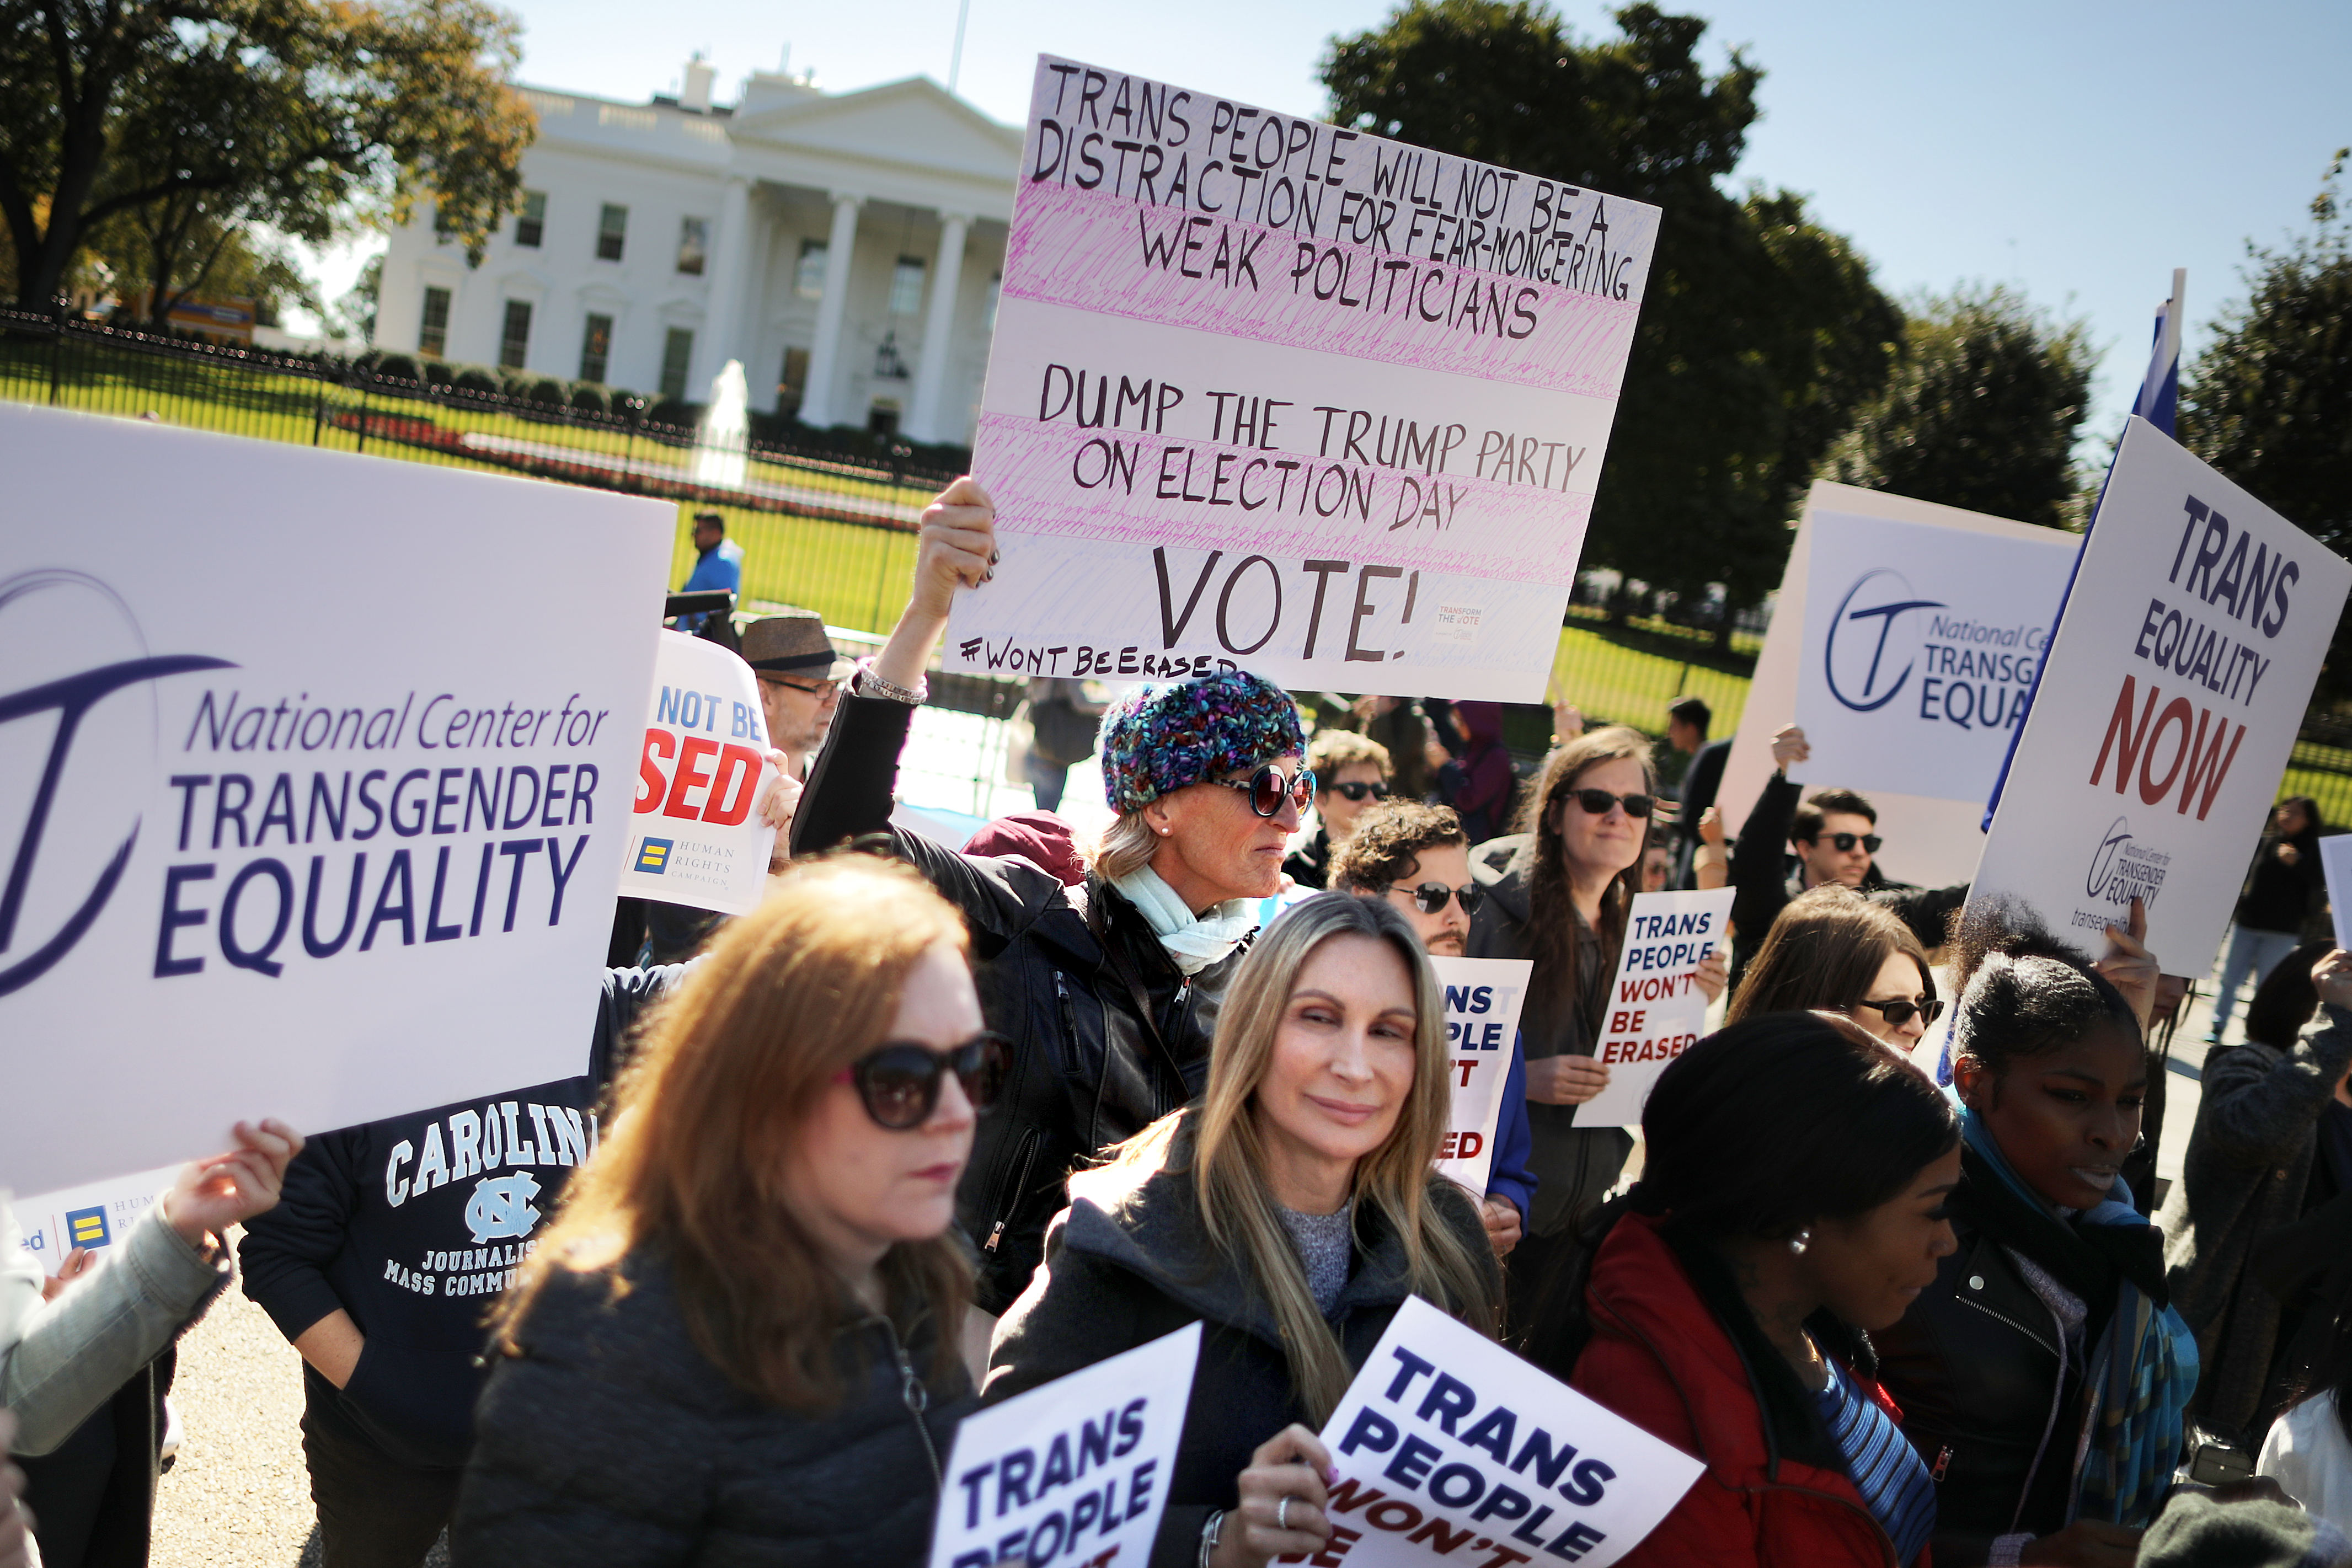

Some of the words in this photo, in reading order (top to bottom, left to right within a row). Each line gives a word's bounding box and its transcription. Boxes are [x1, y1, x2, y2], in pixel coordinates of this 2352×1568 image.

[1050, 64, 1191, 147] TRANS
[1208, 100, 1358, 186] PEOPLE
[1373, 145, 1442, 210] WILL
[1455, 163, 1519, 224] NOT
[1530, 180, 1580, 241] BE
[1585, 195, 1609, 245] A
[1031, 119, 1324, 239] DISTRACTION
[1335, 190, 1396, 255] FOR
[1406, 208, 1632, 301] FEAR-MONGERING
[1140, 209, 1266, 292] WEAK
[1291, 242, 1539, 339] POLITICIANS
[1039, 363, 1184, 435] DUMP
[1206, 391, 1294, 451] THE
[1313, 406, 1467, 477] TRUMP
[1476, 430, 1586, 493] PARTY
[1073, 438, 1140, 496] ON
[1156, 446, 1375, 524] ELECTION
[1388, 476, 1469, 531] DAY
[2169, 494, 2300, 639] TRANS
[1153, 545, 1420, 662] VOTE!
[1439, 613, 1455, 623] THE
[1440, 606, 1482, 616] TRANSFORM
[1929, 614, 2023, 649] National
[2135, 597, 2270, 707] EQUALITY
[184, 690, 415, 752] National
[418, 693, 554, 749] Center
[553, 693, 610, 750] for
[657, 685, 722, 732] NOT
[731, 700, 762, 742] BE
[2089, 674, 2247, 822] NOW
[169, 763, 599, 851] TRANSGENDER
[671, 870, 728, 886] CAMPAIGN
[675, 855, 731, 873] RIGHTS
[679, 841, 735, 858] HUMAN
[2116, 858, 2166, 886] TRANSGENDER
[2125, 842, 2149, 859] National
[2145, 848, 2163, 864] Center
[154, 834, 590, 979] EQUALITY
[1634, 912, 1712, 940] TRANS
[1626, 941, 1714, 972] PEOPLE
[1621, 972, 1695, 1003] WON'T
[1602, 1033, 1697, 1063] ERASED
[1610, 1010, 1646, 1034] BE
[384, 1259, 435, 1296] MASS
[422, 1238, 544, 1271] JOURNALIS
[1384, 1345, 1617, 1507] TRANS
[960, 1397, 1147, 1531] TRANS
[1338, 1405, 1607, 1563] PEOPLE
